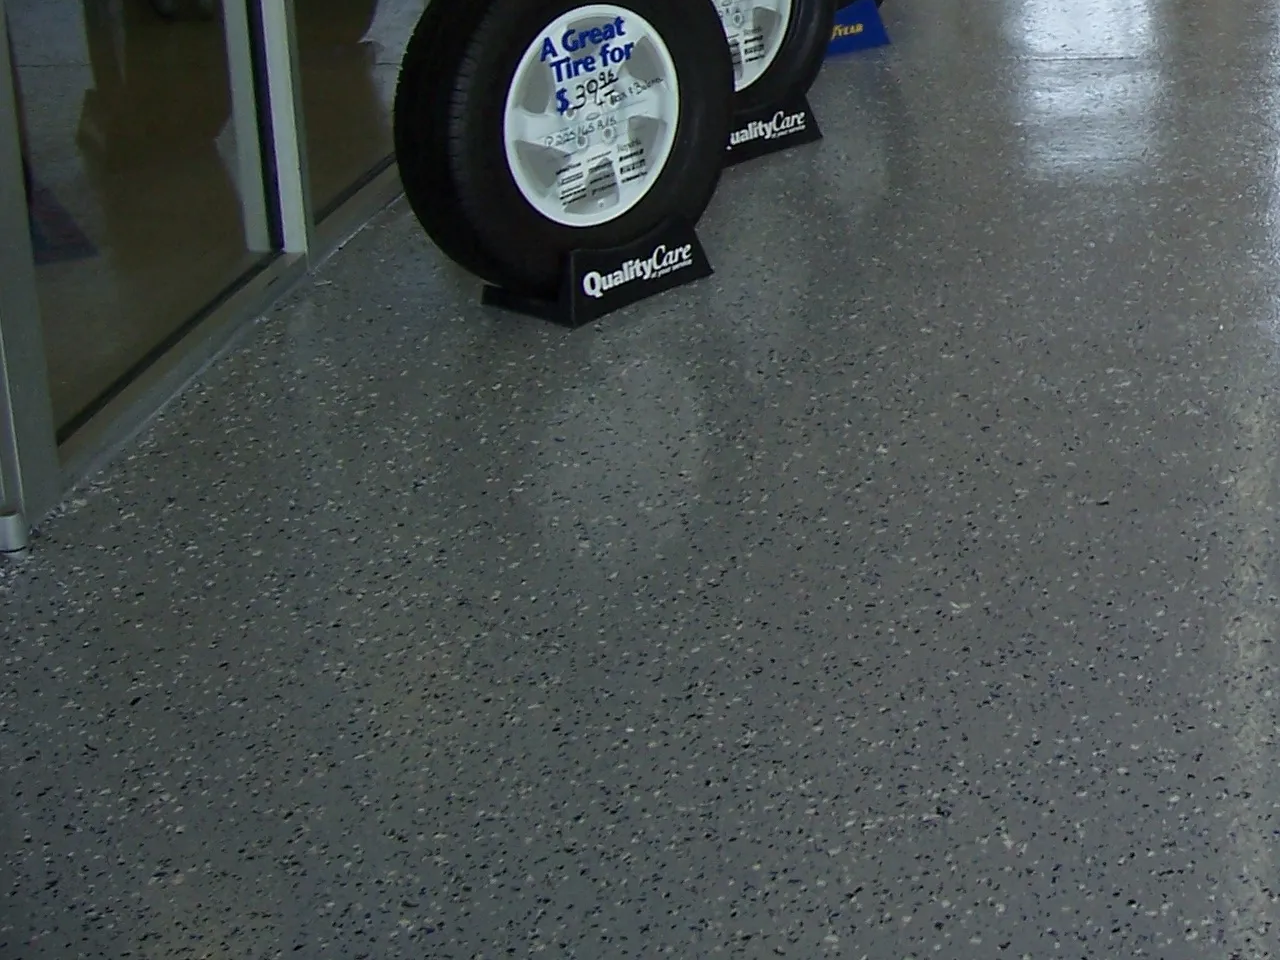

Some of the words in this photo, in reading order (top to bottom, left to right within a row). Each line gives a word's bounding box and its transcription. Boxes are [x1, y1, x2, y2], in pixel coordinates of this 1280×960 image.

[540, 37, 557, 62] A
[561, 16, 625, 52] Great
[551, 57, 596, 83] Tire
[600, 41, 634, 67] for
[726, 110, 806, 150] ualityCare
[583, 243, 692, 298] QualityCare
